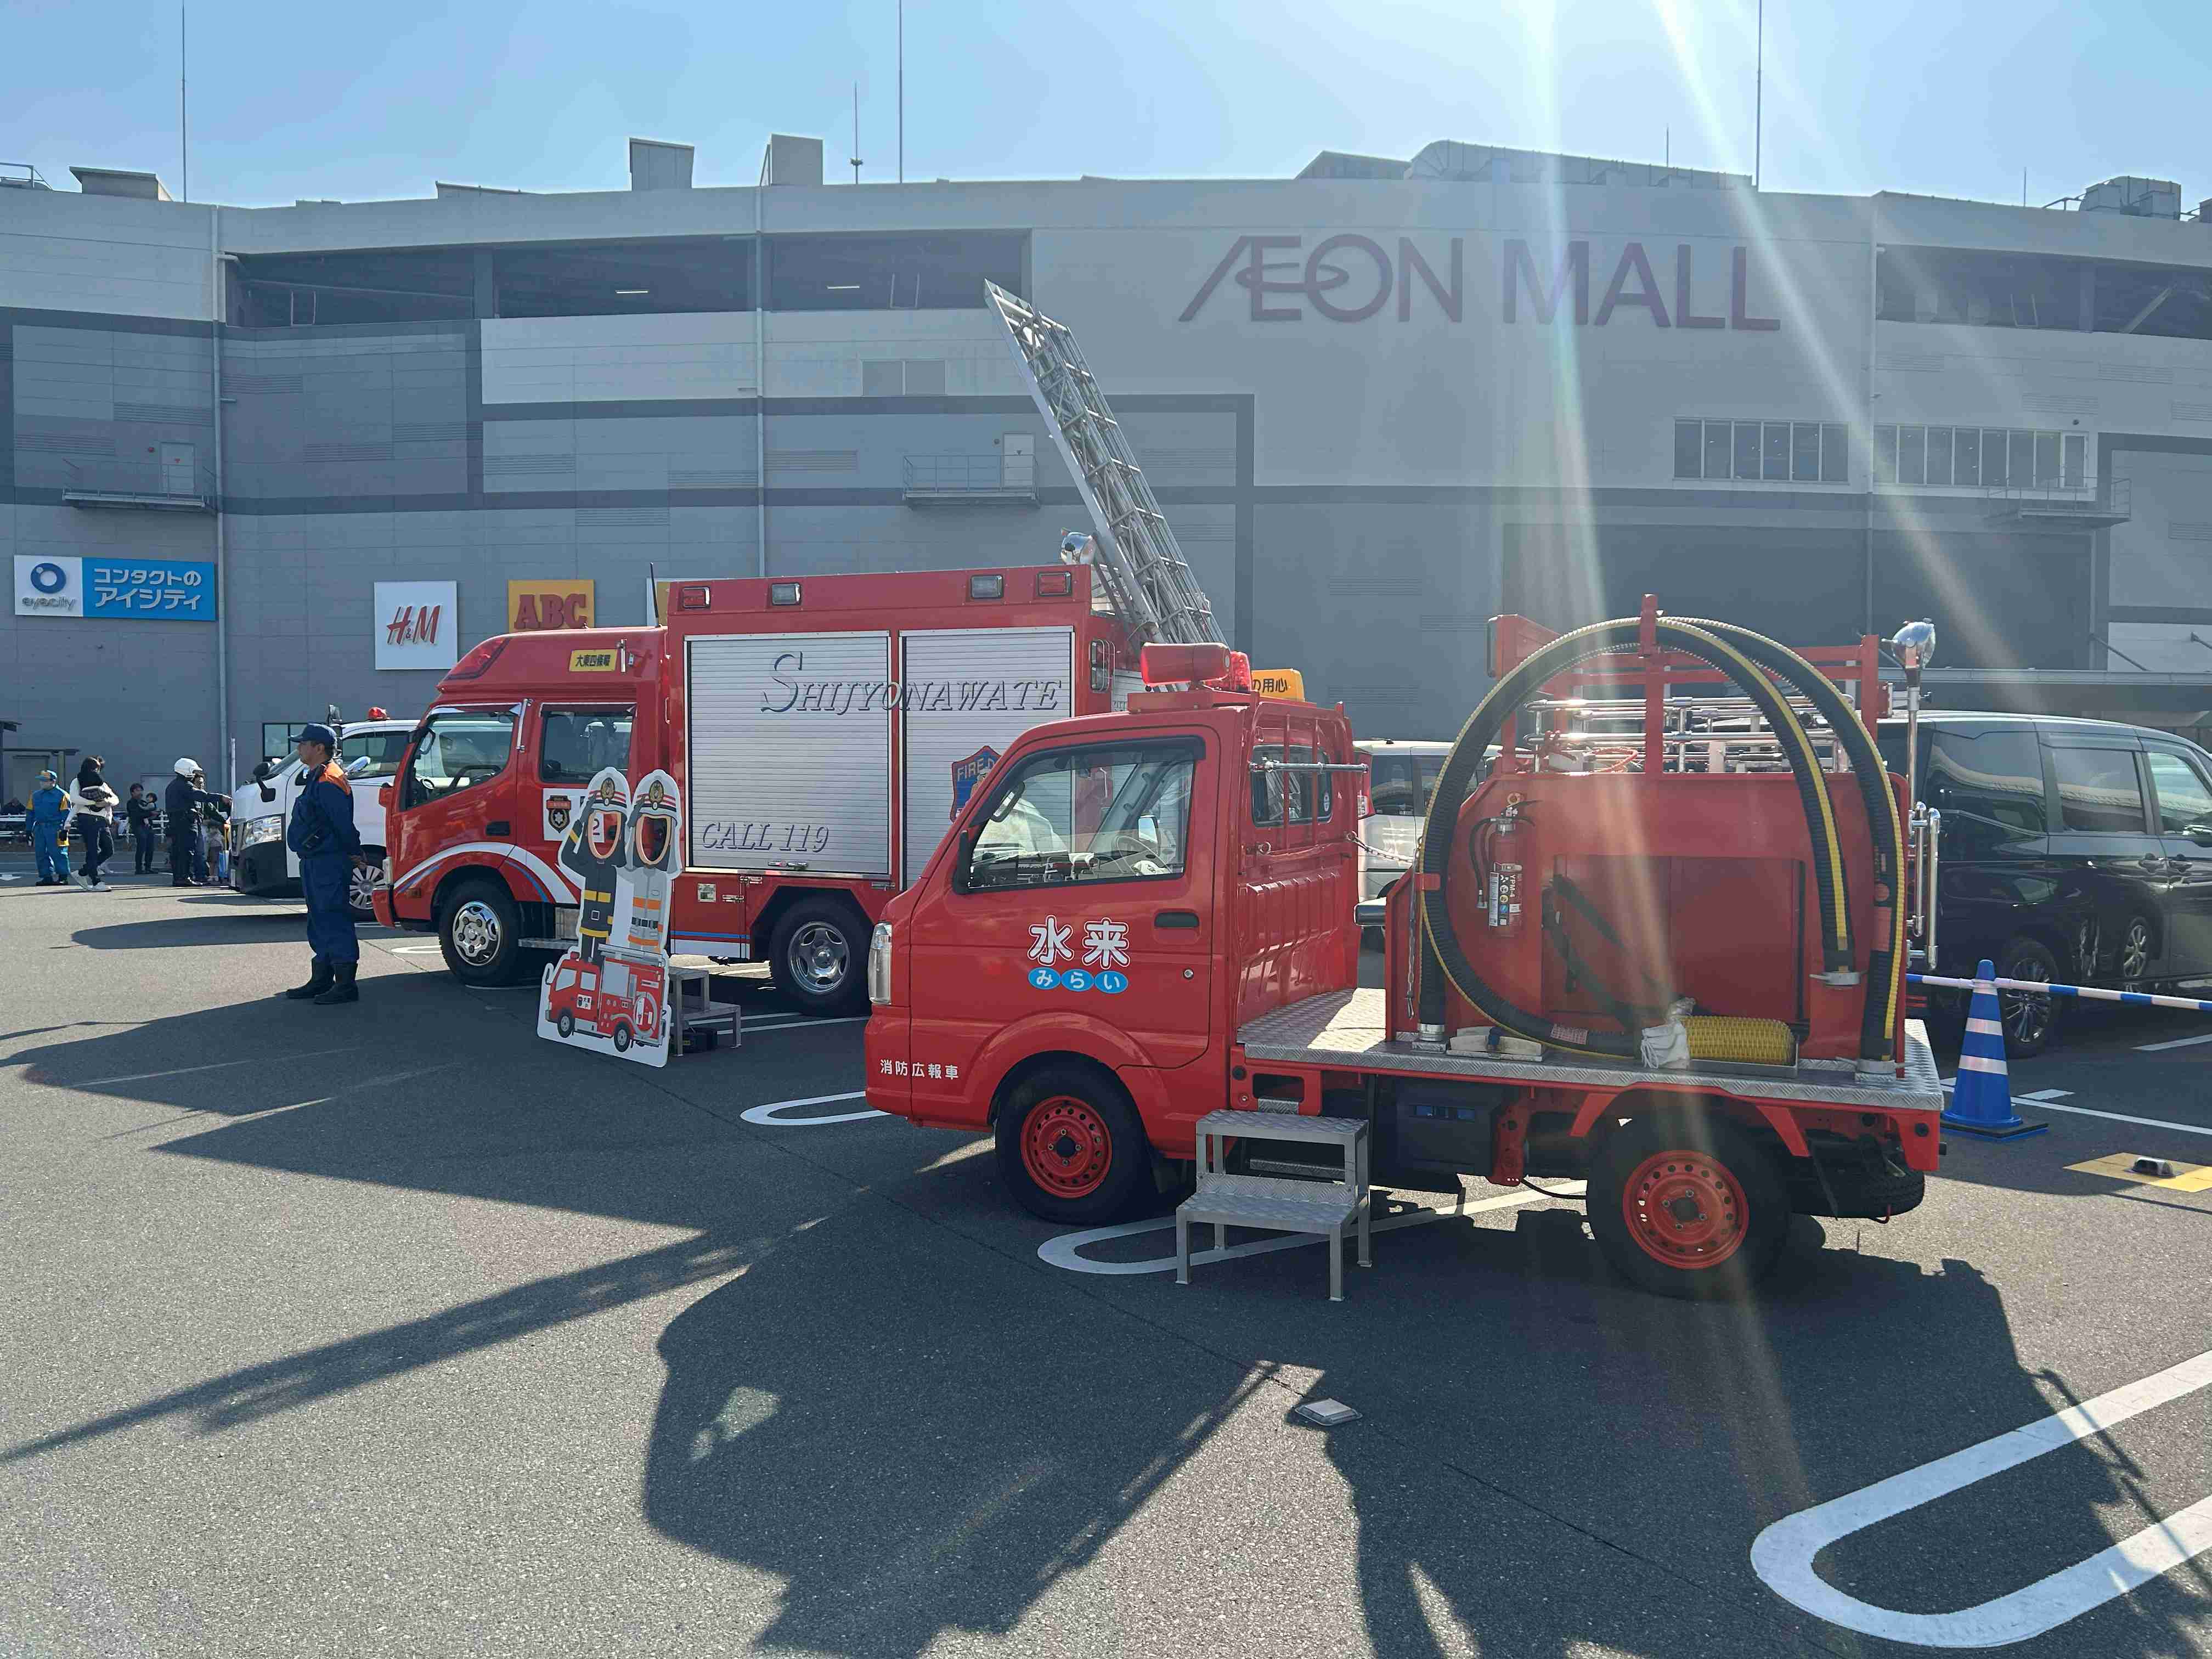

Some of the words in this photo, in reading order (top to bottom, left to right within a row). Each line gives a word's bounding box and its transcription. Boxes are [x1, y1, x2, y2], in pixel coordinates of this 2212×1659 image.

[1503, 239, 1781, 330] MALL
[94, 567, 202, 586] コンタクトの
[94, 586, 202, 610] アイシティ
[514, 593, 588, 629] ABC
[386, 605, 441, 645] H&M
[957, 758, 984, 781] FIRE
[702, 822, 772, 850] CALL
[779, 825, 829, 853] 119
[1028, 915, 1130, 968] 水来
[1035, 970, 1120, 991] みらい
[880, 1059, 960, 1080] 消防広報車
